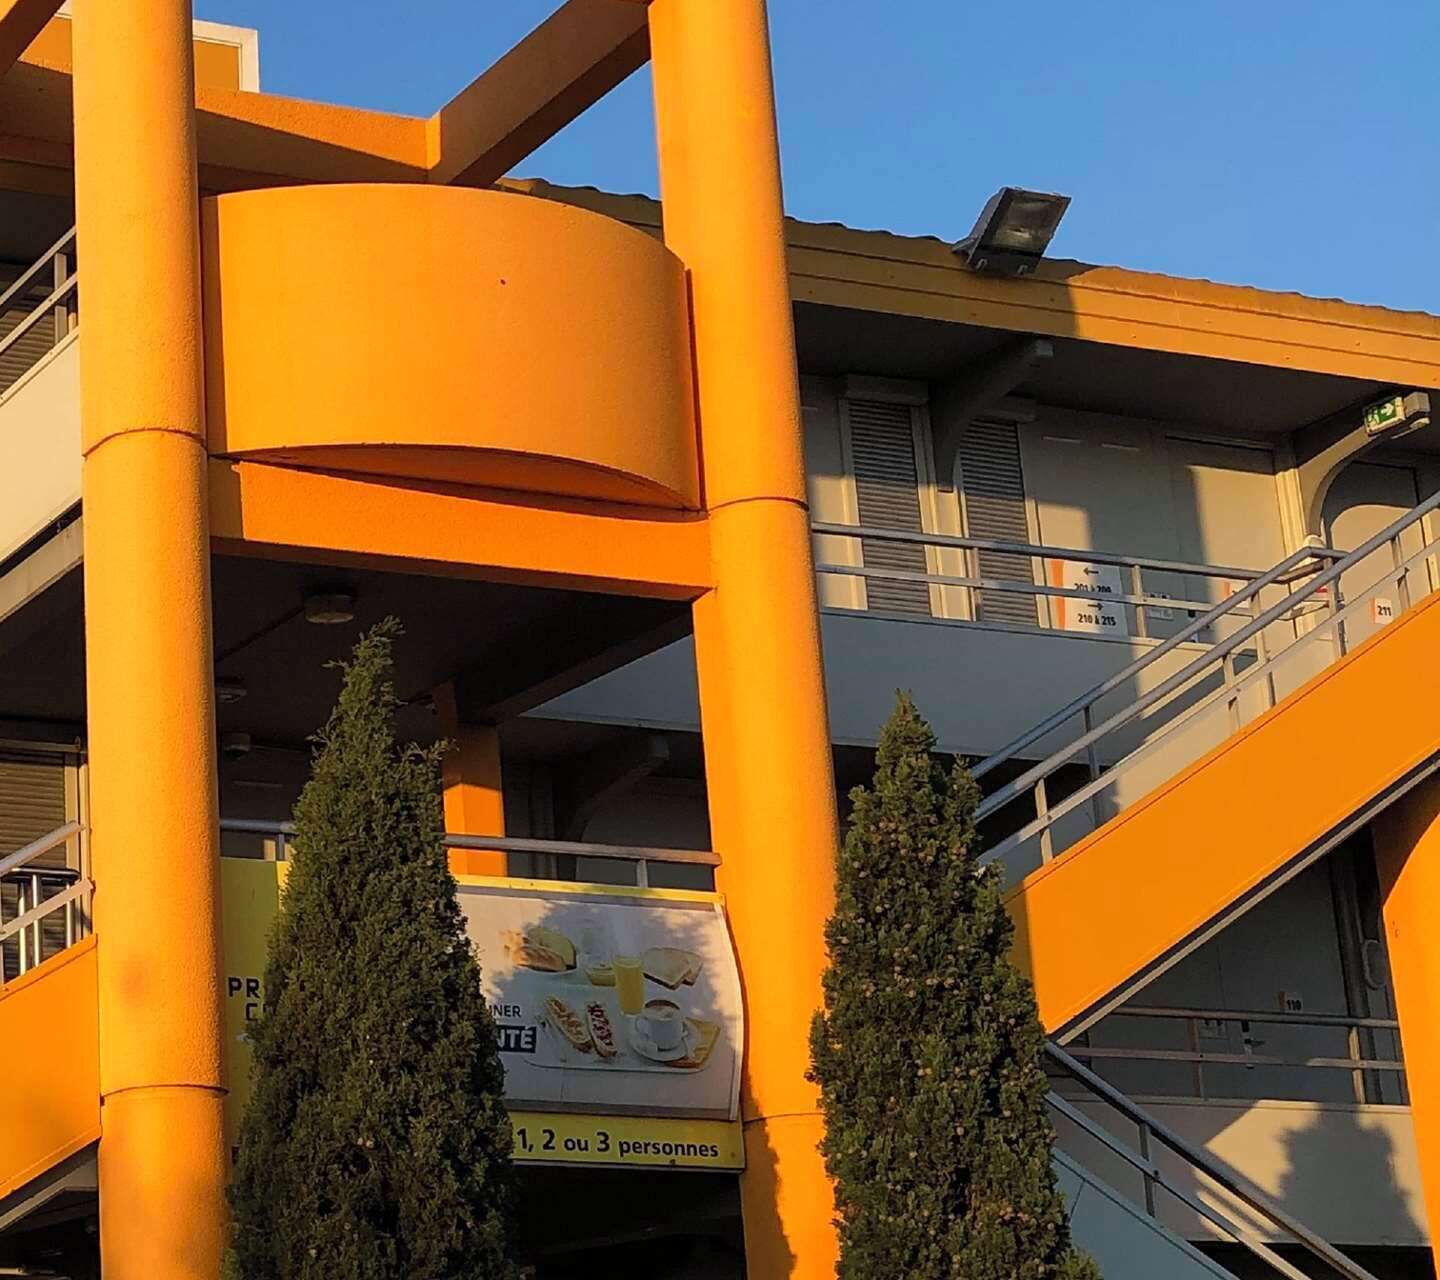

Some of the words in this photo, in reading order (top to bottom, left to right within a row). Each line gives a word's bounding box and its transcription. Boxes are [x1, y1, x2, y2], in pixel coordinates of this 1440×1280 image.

[1377, 605, 1391, 616] 211
[1077, 613, 1093, 624] 210
[1101, 616, 1116, 626] 215
[542, 1129, 556, 1151] 2
[564, 1137, 589, 1152] ou
[596, 1131, 610, 1152] 3
[618, 1139, 719, 1158] personnes
